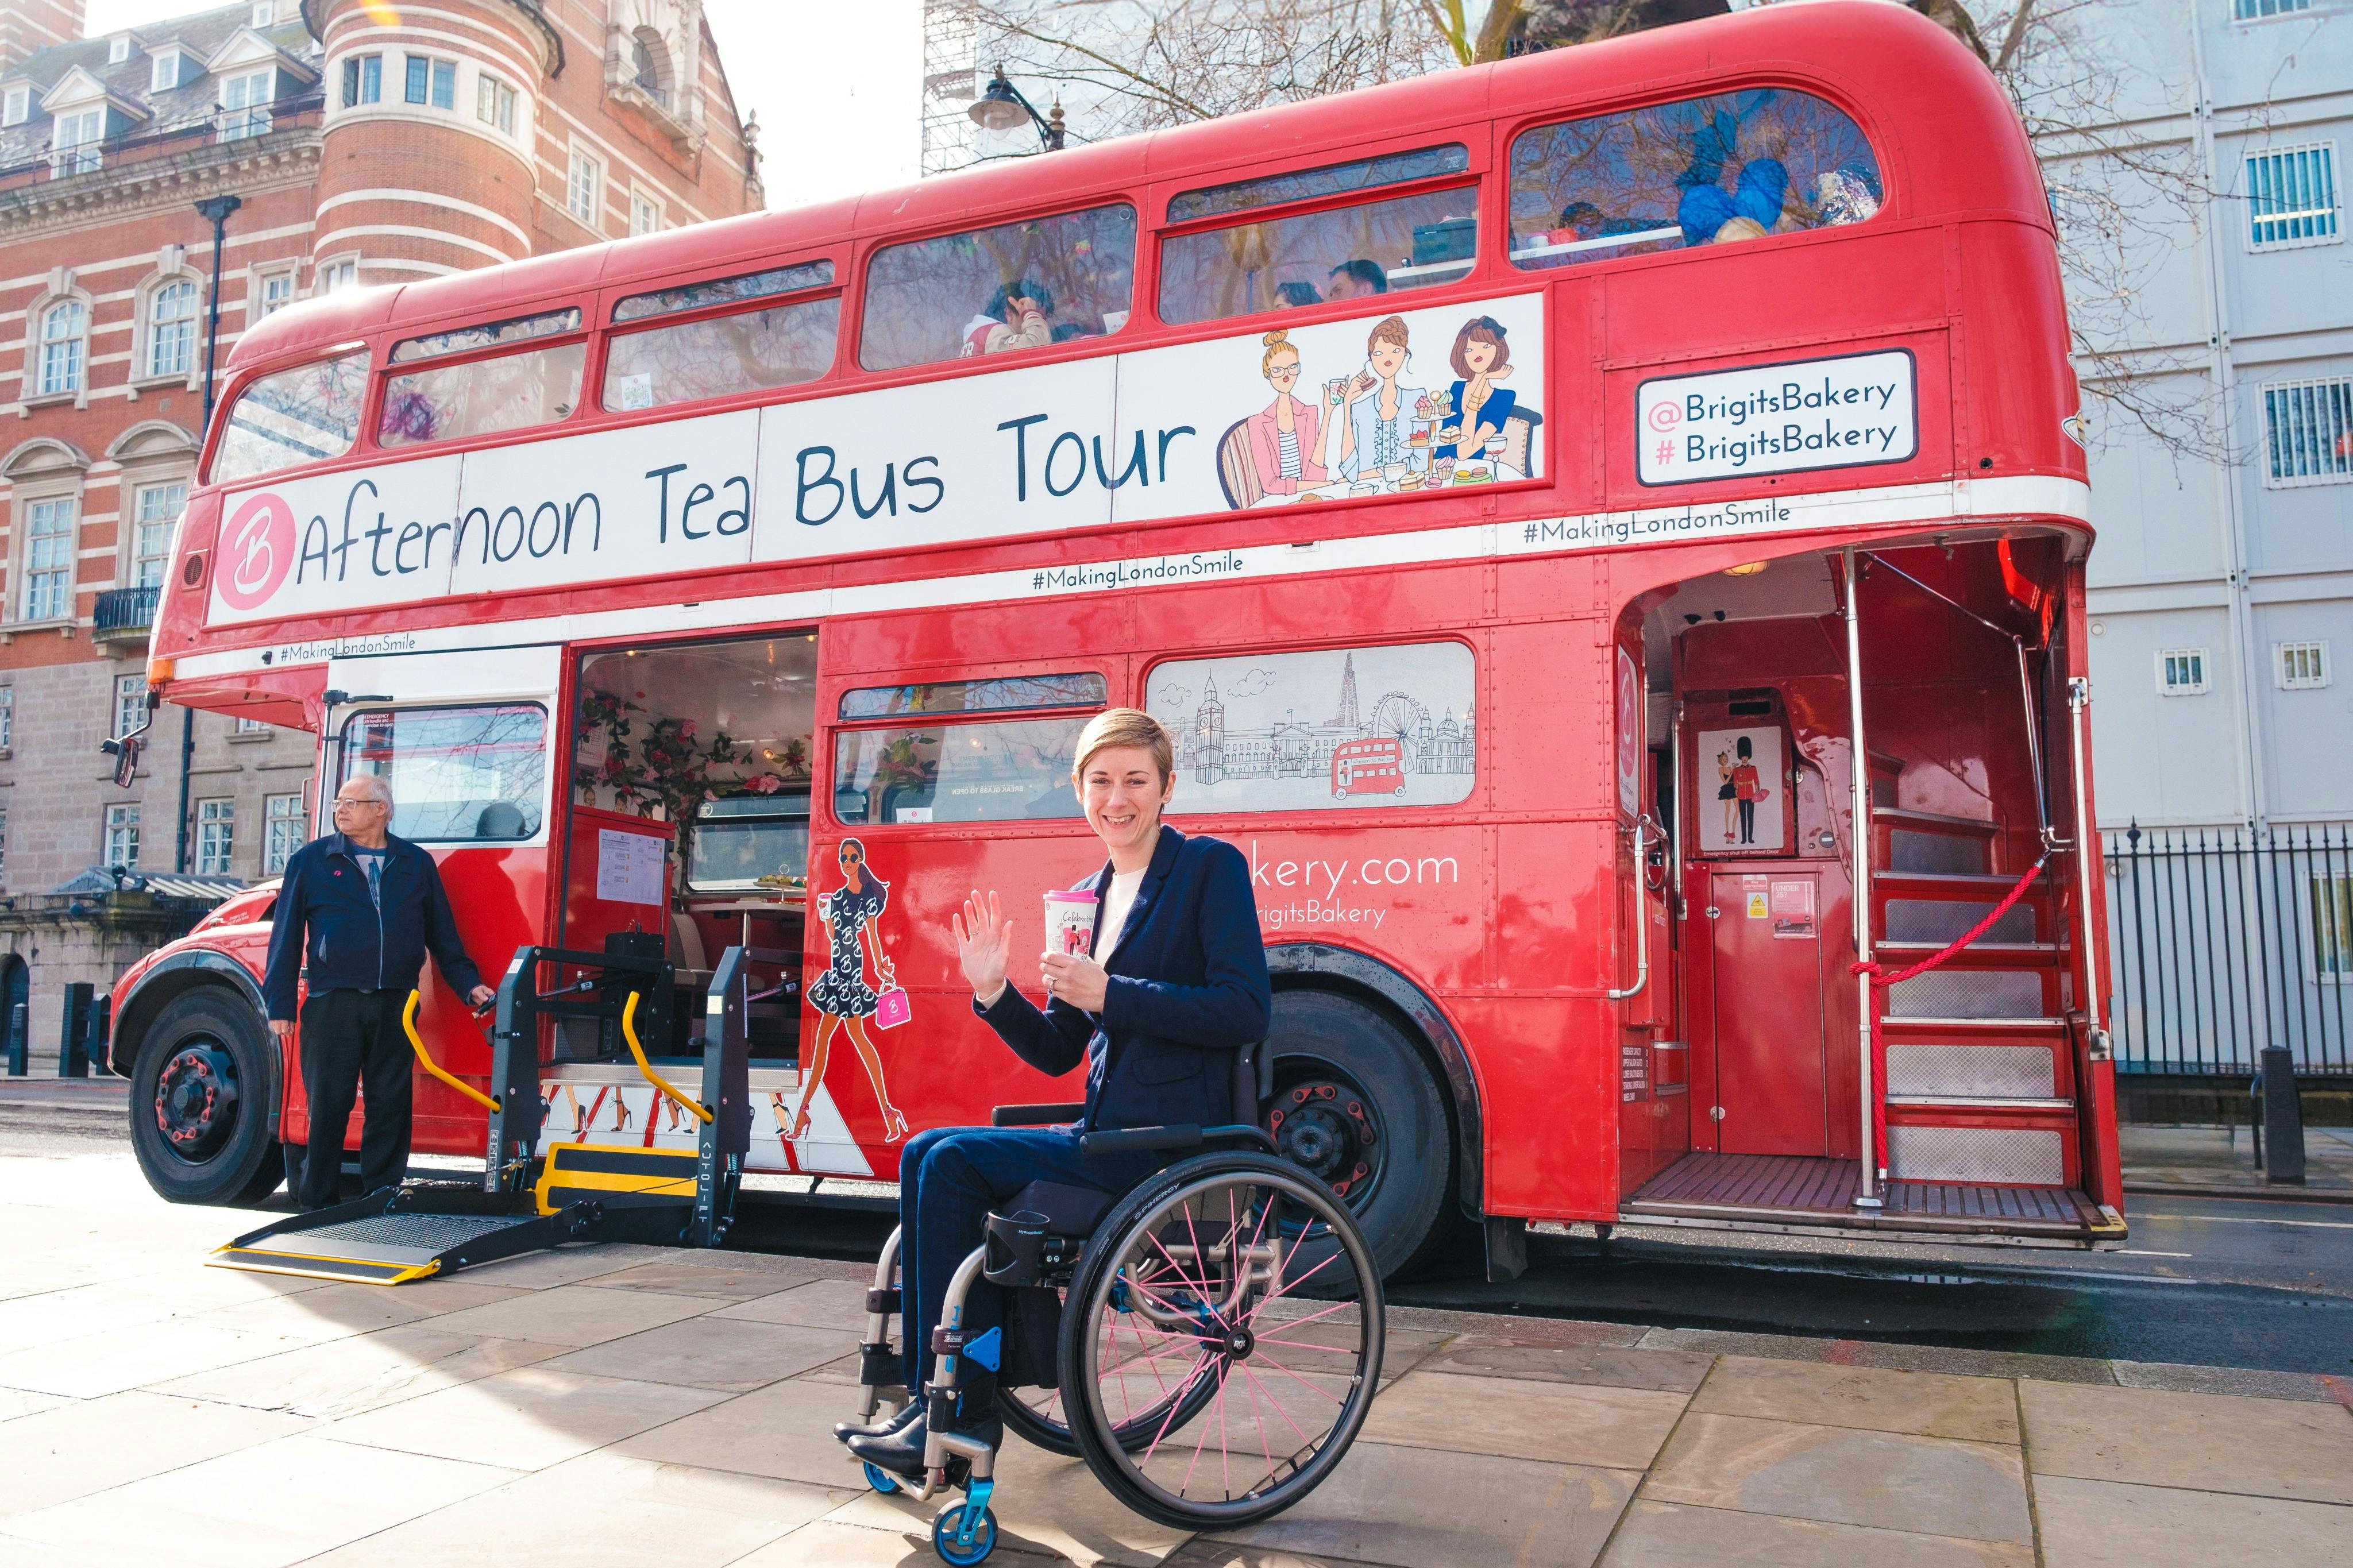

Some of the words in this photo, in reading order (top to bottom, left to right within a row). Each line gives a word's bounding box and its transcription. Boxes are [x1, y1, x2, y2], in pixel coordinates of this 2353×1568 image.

[1648, 377, 1896, 433] @BrigitsBakery
[297, 479, 601, 585] Afternoon
[645, 464, 751, 543] Tea
[796, 445, 945, 526] Bus
[997, 413, 1196, 502] Tour
[1523, 499, 1791, 544] #MakingLondonSmile
[1033, 550, 1243, 590] #MakingLondonSmile
[280, 636, 416, 663] #MakingLondonSmile
[1252, 840, 1457, 899] kery.com
[1257, 898, 1386, 929] rigitsBakery
[699, 1141, 712, 1223] AUTOLIFT
[1133, 1183, 1180, 1221] SPINERGY
